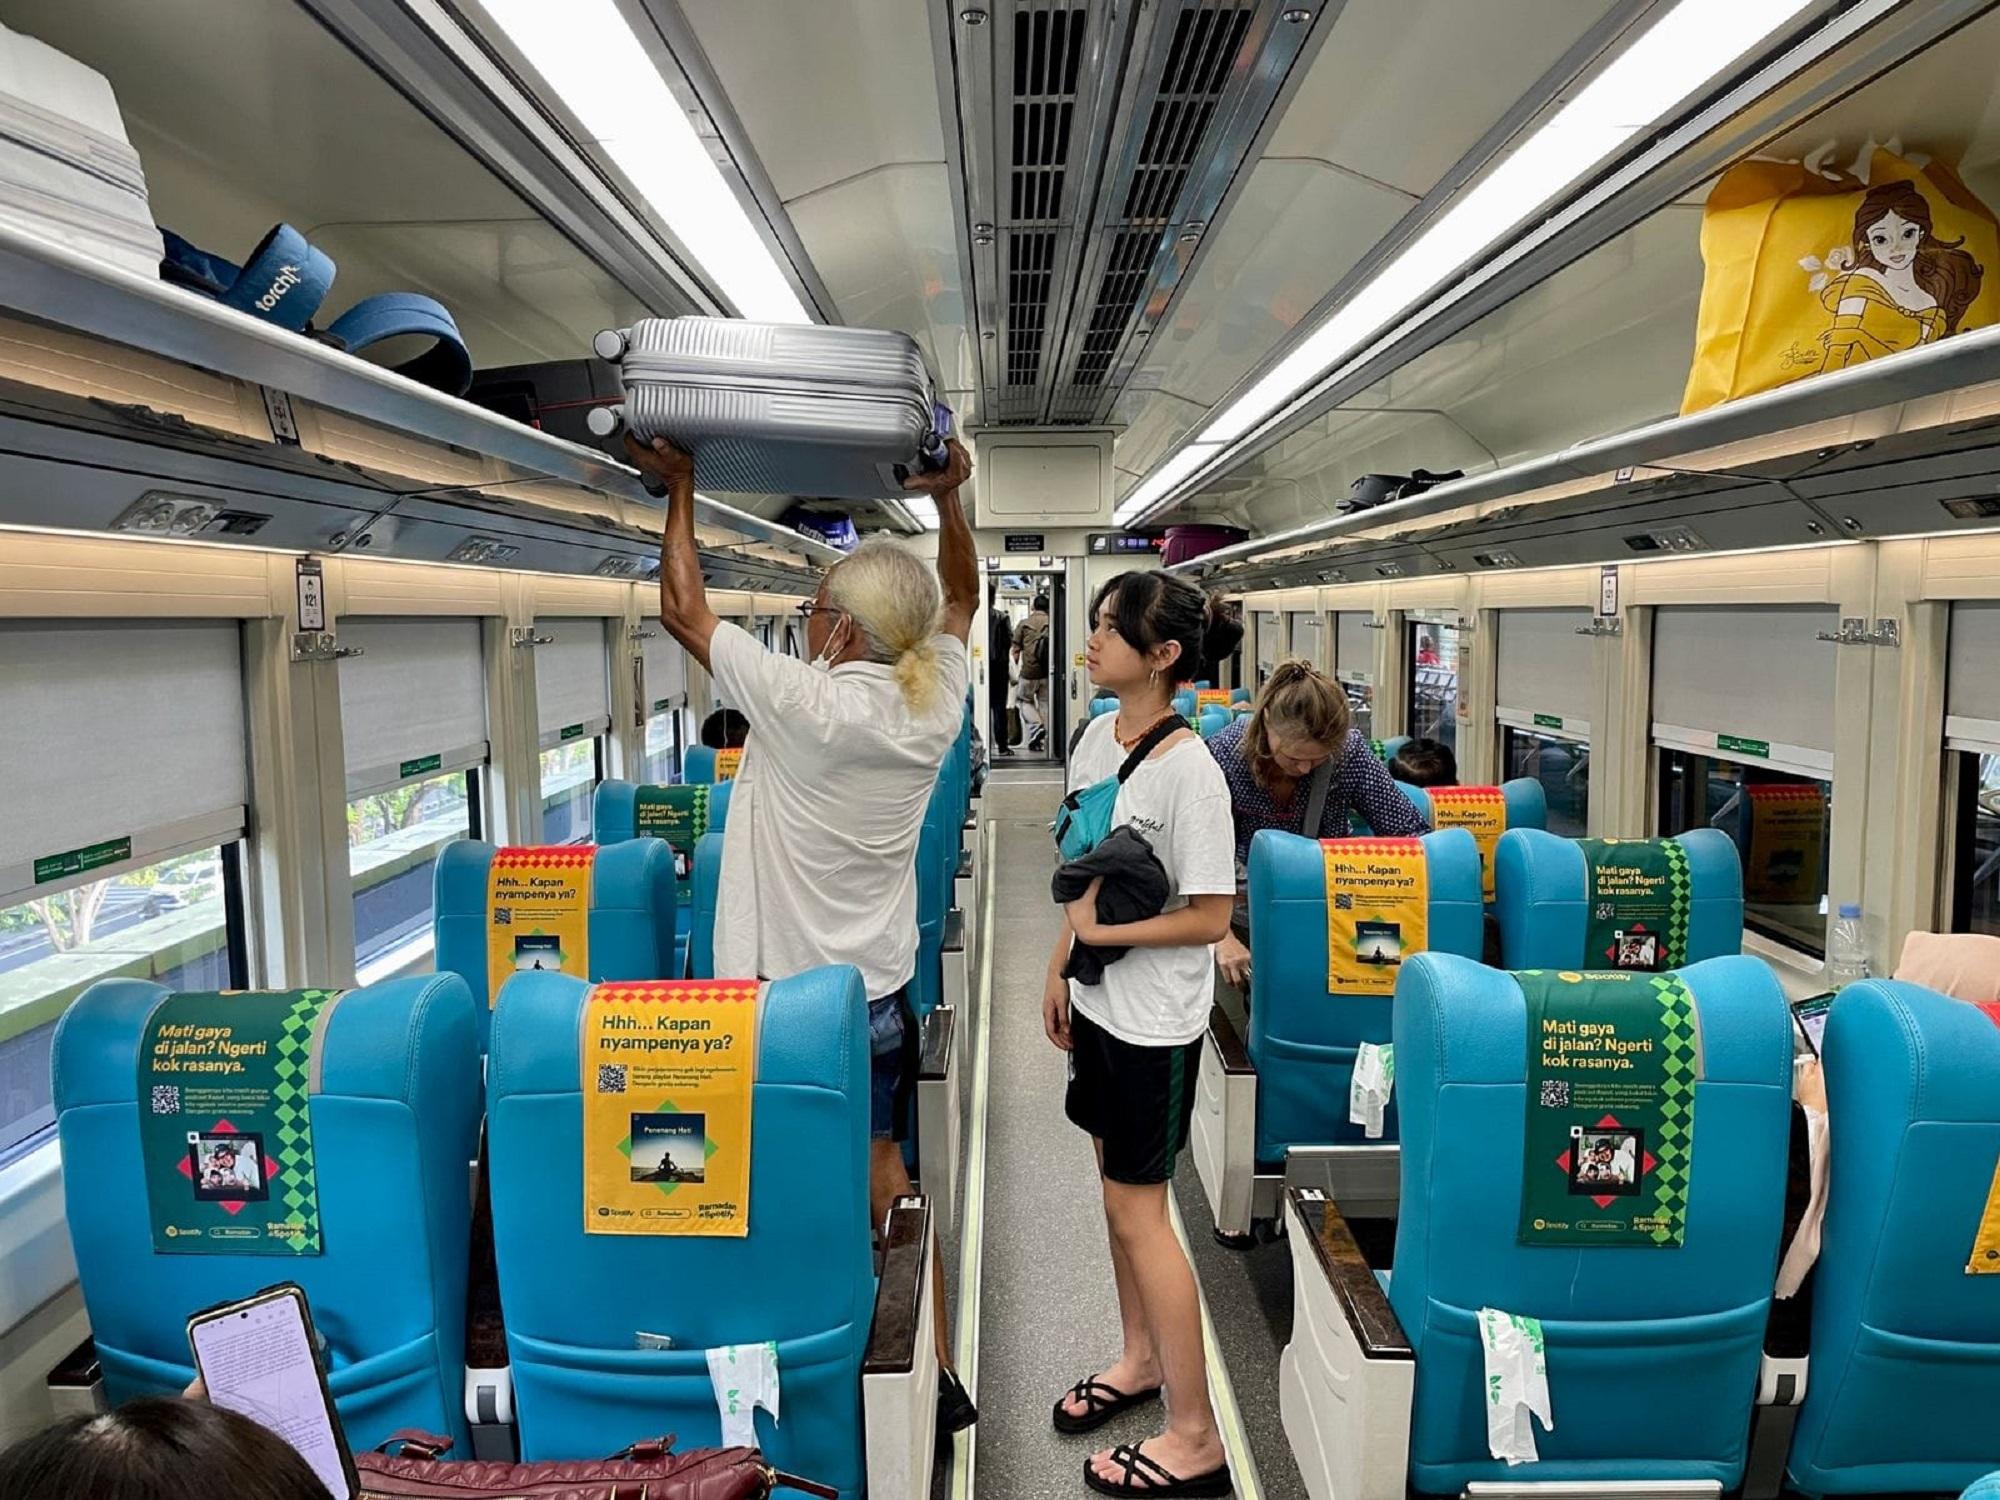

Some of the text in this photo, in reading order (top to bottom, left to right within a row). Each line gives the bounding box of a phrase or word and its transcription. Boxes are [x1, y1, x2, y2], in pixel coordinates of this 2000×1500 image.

[304, 593, 317, 607] 121
[1367, 864, 1400, 876] Kapan
[1596, 865, 1641, 876] Mati gaya
[530, 877, 564, 889] Kapan
[1335, 877, 1415, 888] nyampenya ya?
[1597, 876, 1665, 886] di jalan? Ngerti
[495, 889, 576, 900] nyampenya ya?
[1597, 886, 1654, 896] kok rasanya.
[602, 1015, 711, 1033] Hhh... Kapan
[1543, 1019, 1615, 1037] Mati gaya
[158, 1024, 232, 1040] Mati gaya
[154, 1040, 268, 1057] di jalan? Ngerti
[600, 1035, 733, 1053] nyampenya ya?
[1543, 1038, 1653, 1055] di jalan? Ngerti
[153, 1058, 246, 1075] kok rasanya.
[1543, 1055, 1634, 1071] kok rasanya.
